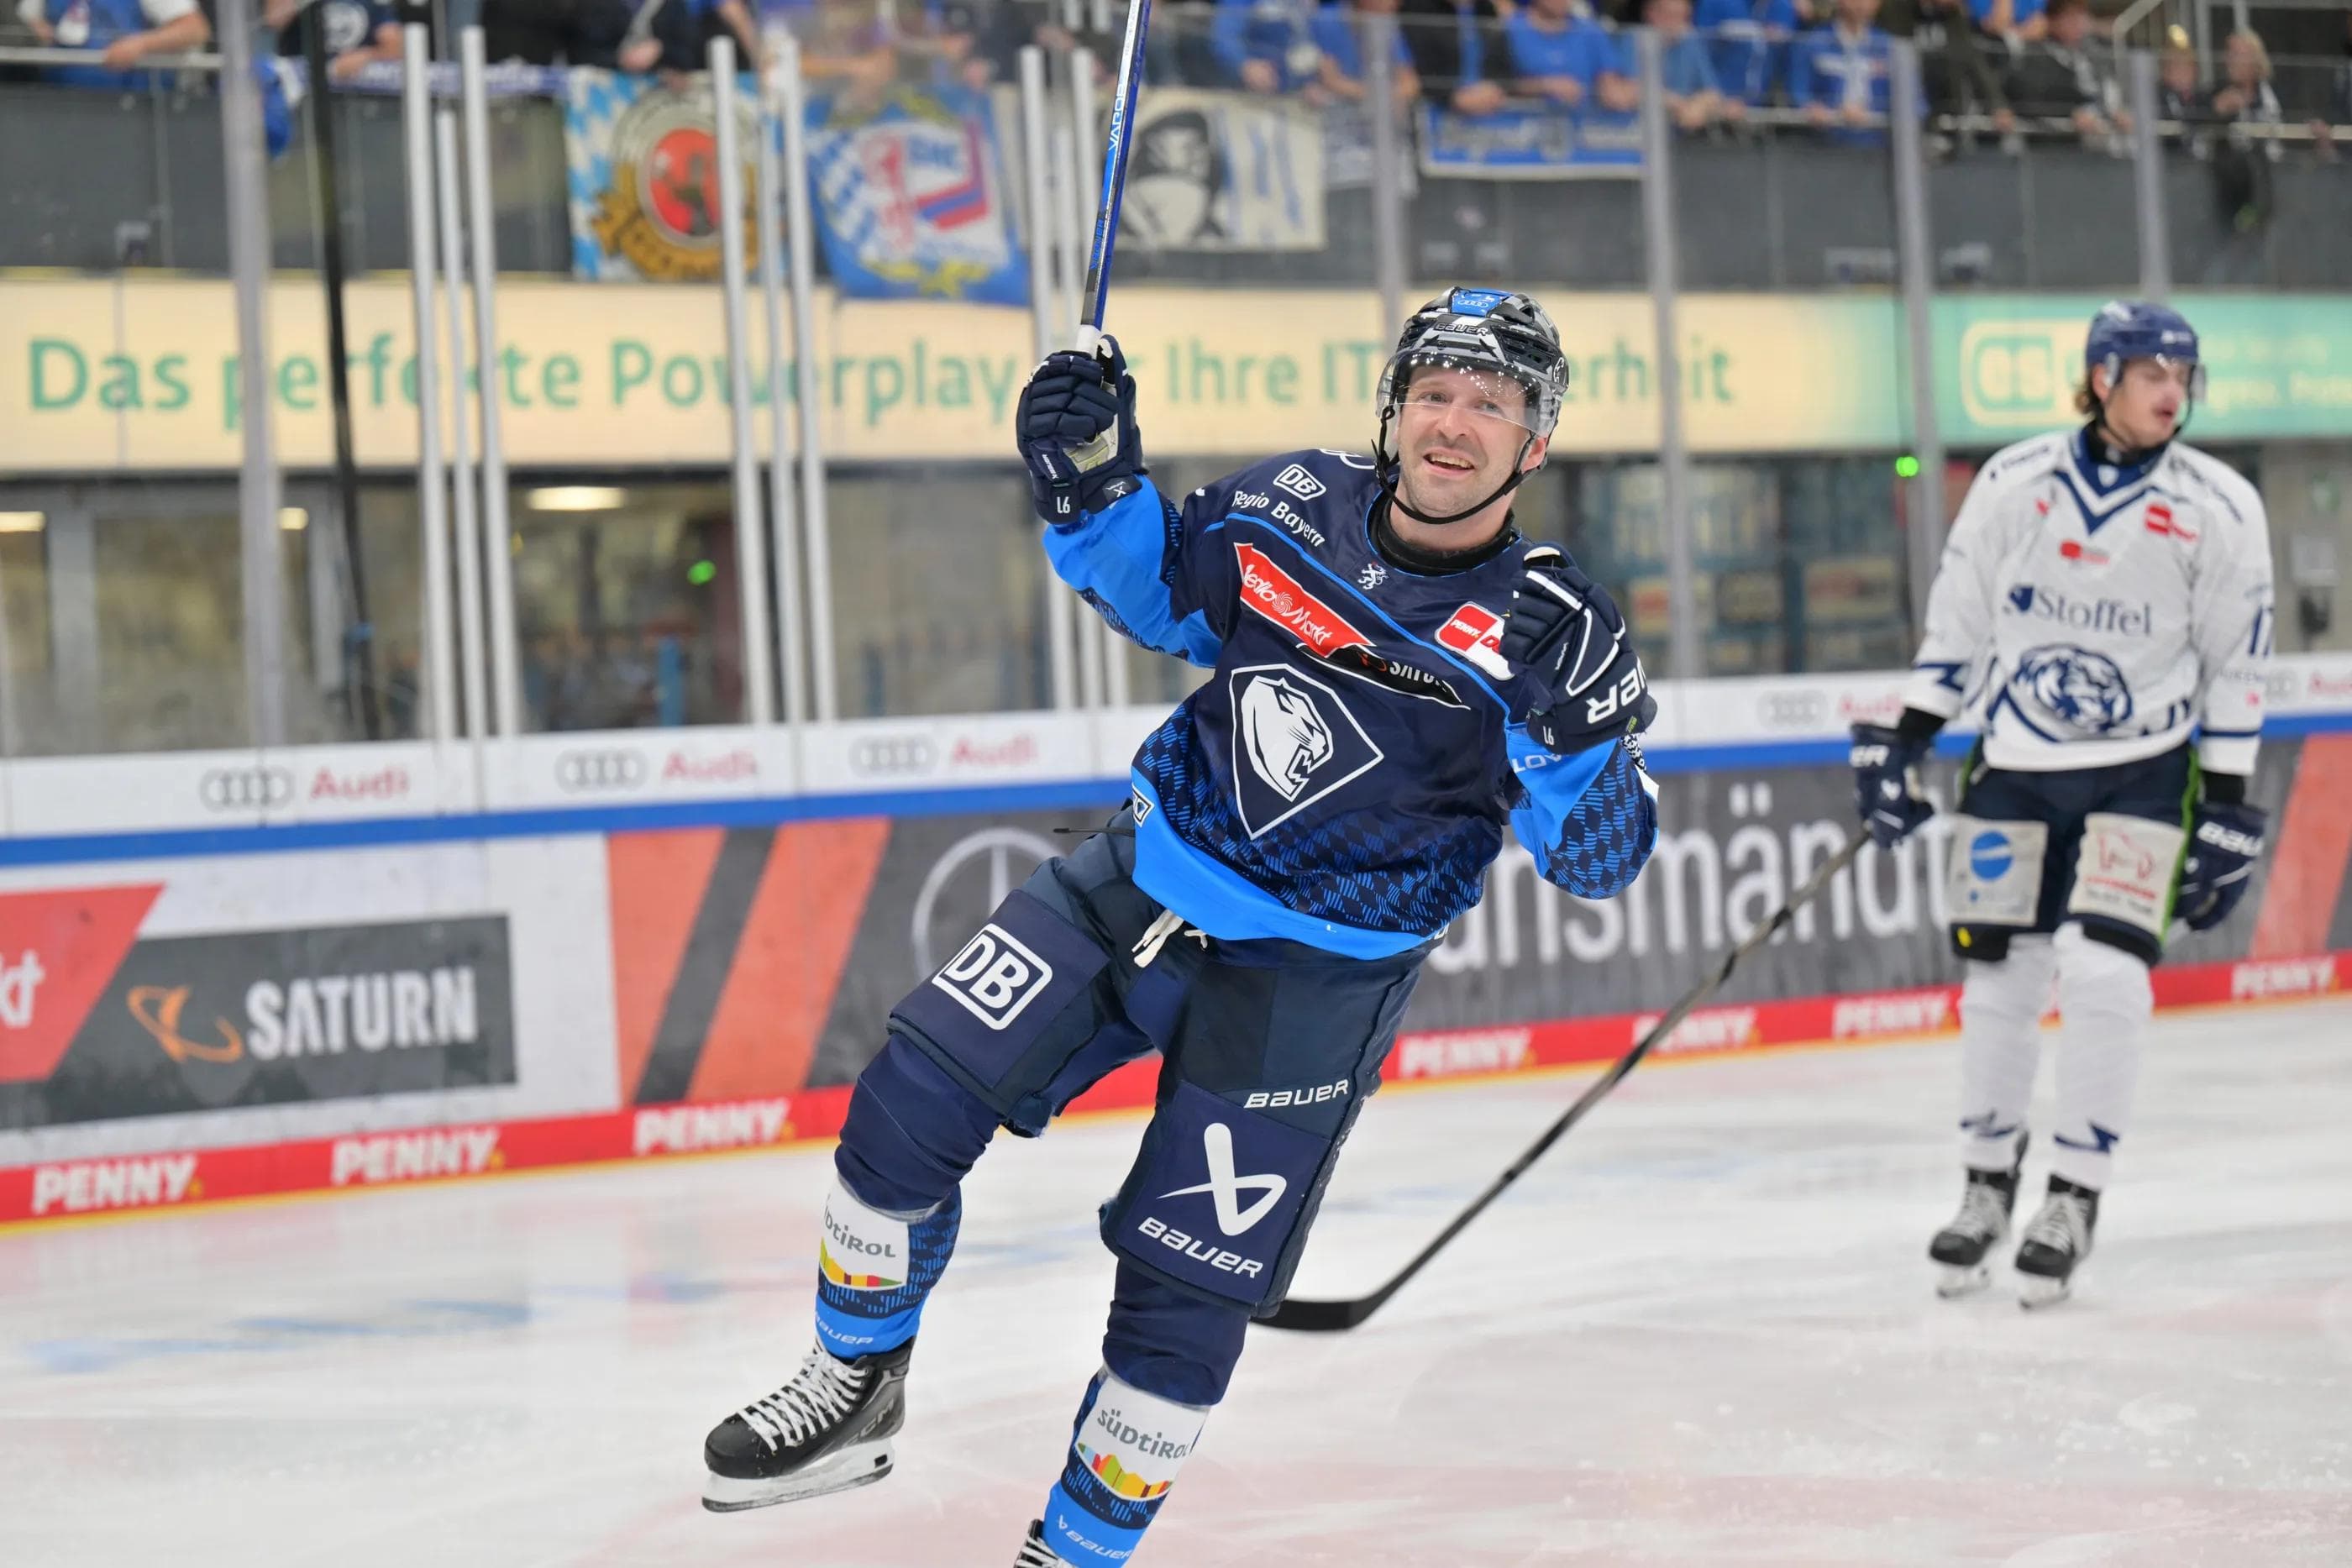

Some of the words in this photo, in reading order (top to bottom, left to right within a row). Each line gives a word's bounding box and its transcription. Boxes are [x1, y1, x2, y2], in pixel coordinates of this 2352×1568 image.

[29, 338, 191, 410] Das
[1168, 340, 1298, 403] Ihre
[1282, 466, 1319, 496] DB
[1231, 490, 1270, 509] Regio
[1271, 501, 1326, 548] Bayern
[2034, 588, 2153, 638] Stoffel
[662, 750, 759, 781] Audi
[950, 732, 1039, 766] Audi
[310, 767, 410, 801] Audi
[947, 932, 1035, 1012] DB
[245, 966, 477, 1062] SATURN
[1244, 1079, 1350, 1109] BAUER
[1138, 1216, 1264, 1279] BAUER
